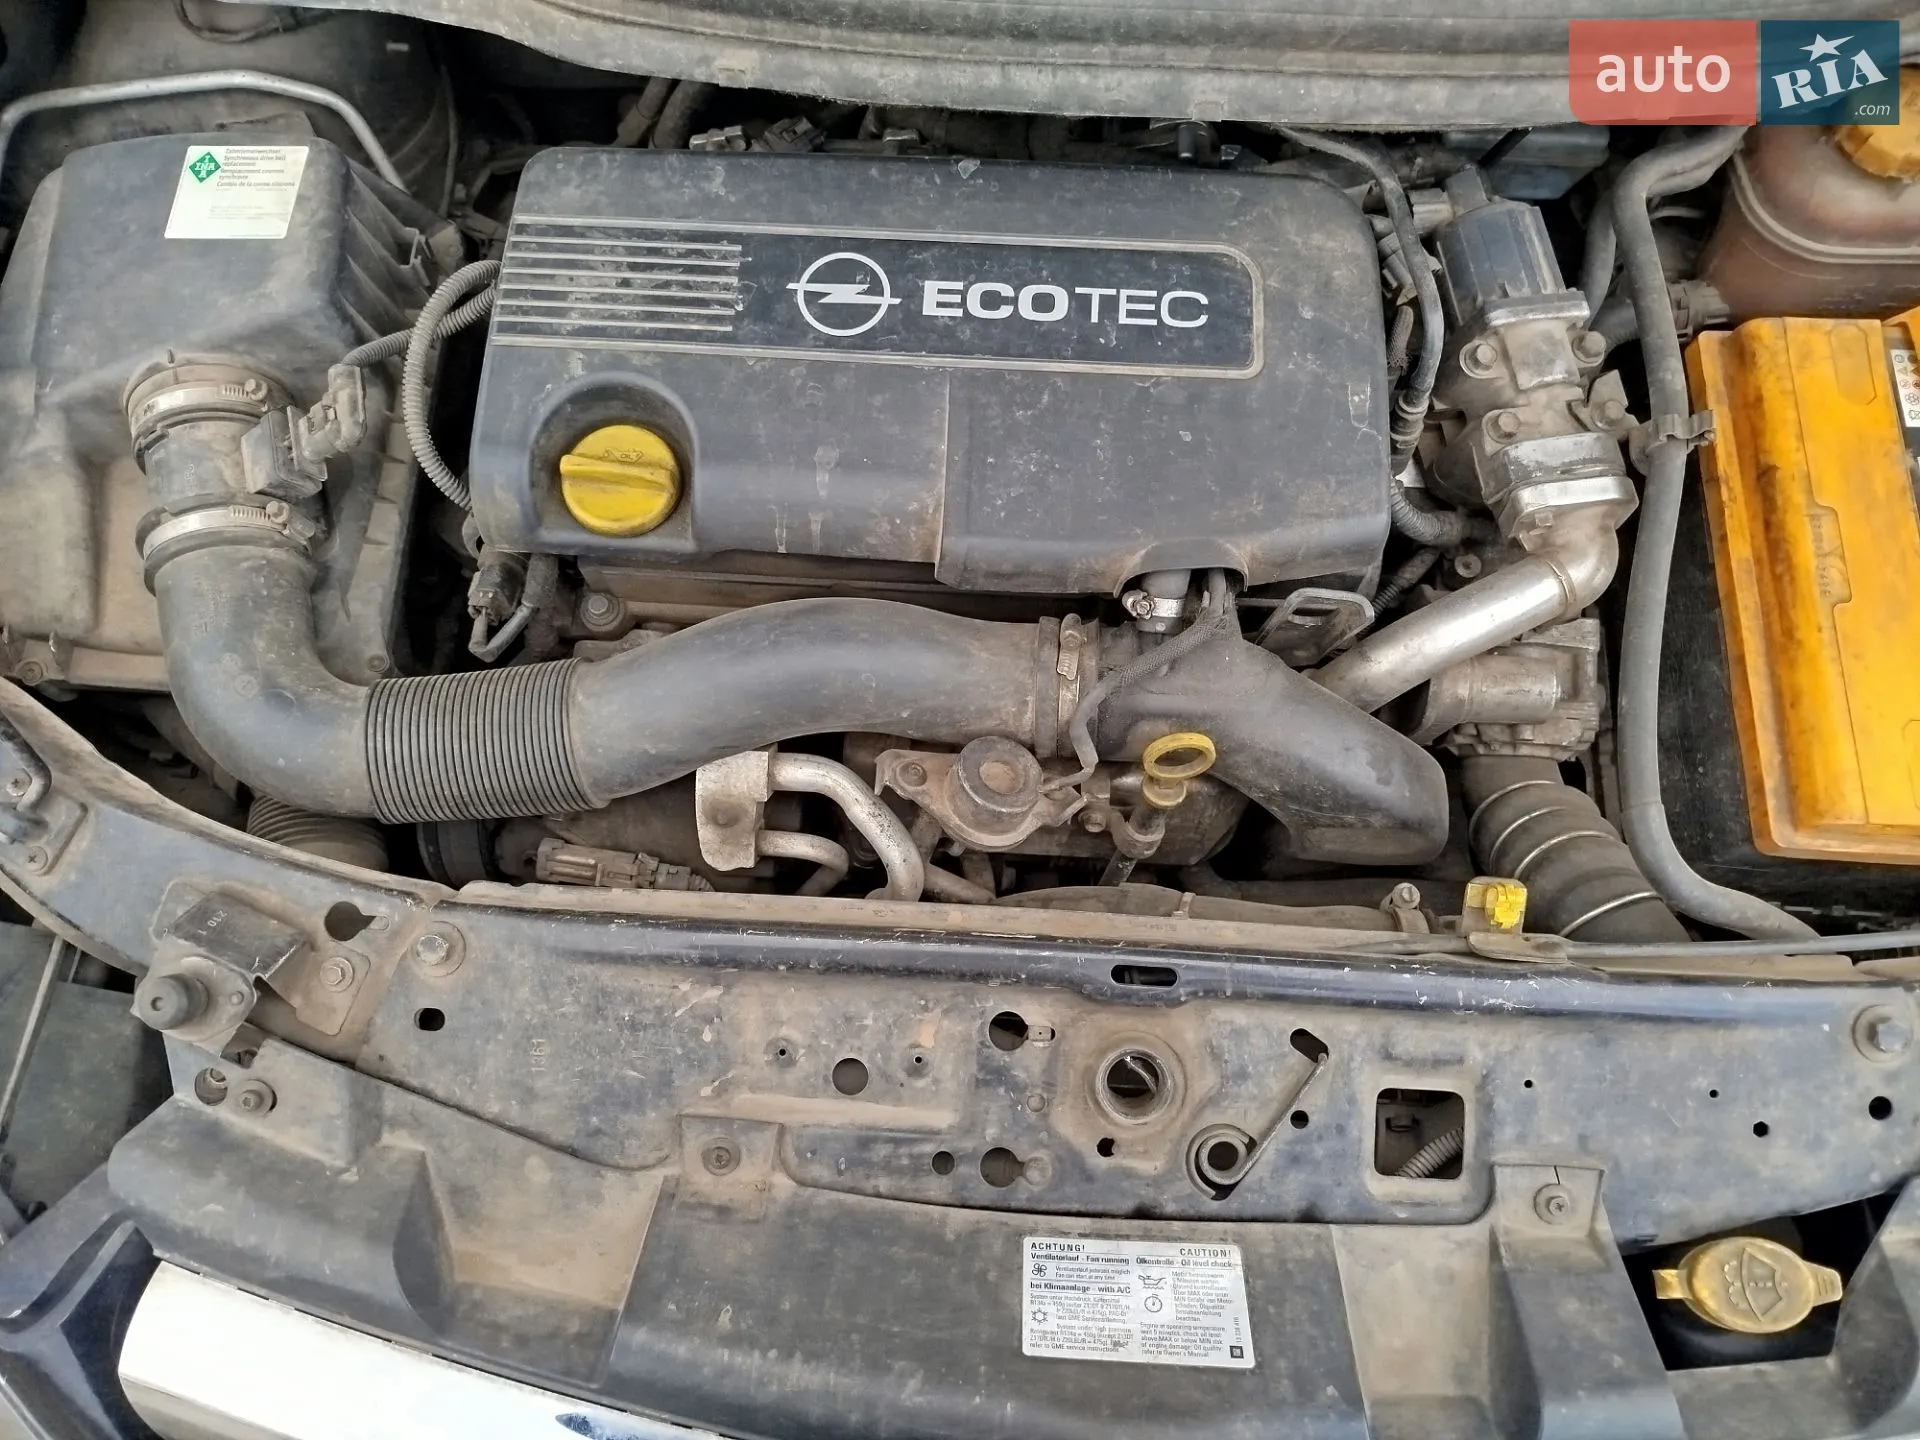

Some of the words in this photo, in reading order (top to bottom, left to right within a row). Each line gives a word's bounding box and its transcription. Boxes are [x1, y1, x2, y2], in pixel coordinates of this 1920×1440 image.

[921, 280, 1210, 328] ECOTEC
[530, 1038, 545, 1071] 1361
[1030, 1242, 1085, 1252] ACHTUNG!
[1179, 1247, 1232, 1258] CAUTION!
[1030, 1252, 1080, 1262] Ventilatorlauf
[1086, 1255, 1100, 1263] Fan
[1101, 1256, 1130, 1265] running
[1181, 1258, 1191, 1266] Oil
[1192, 1259, 1209, 1267] level
[1210, 1260, 1233, 1268] check
[1030, 1281, 1042, 1289] bei
[1043, 1282, 1091, 1294] Klimaanlage
[1097, 1285, 1115, 1294] with
[1116, 1286, 1131, 1294] A/C
